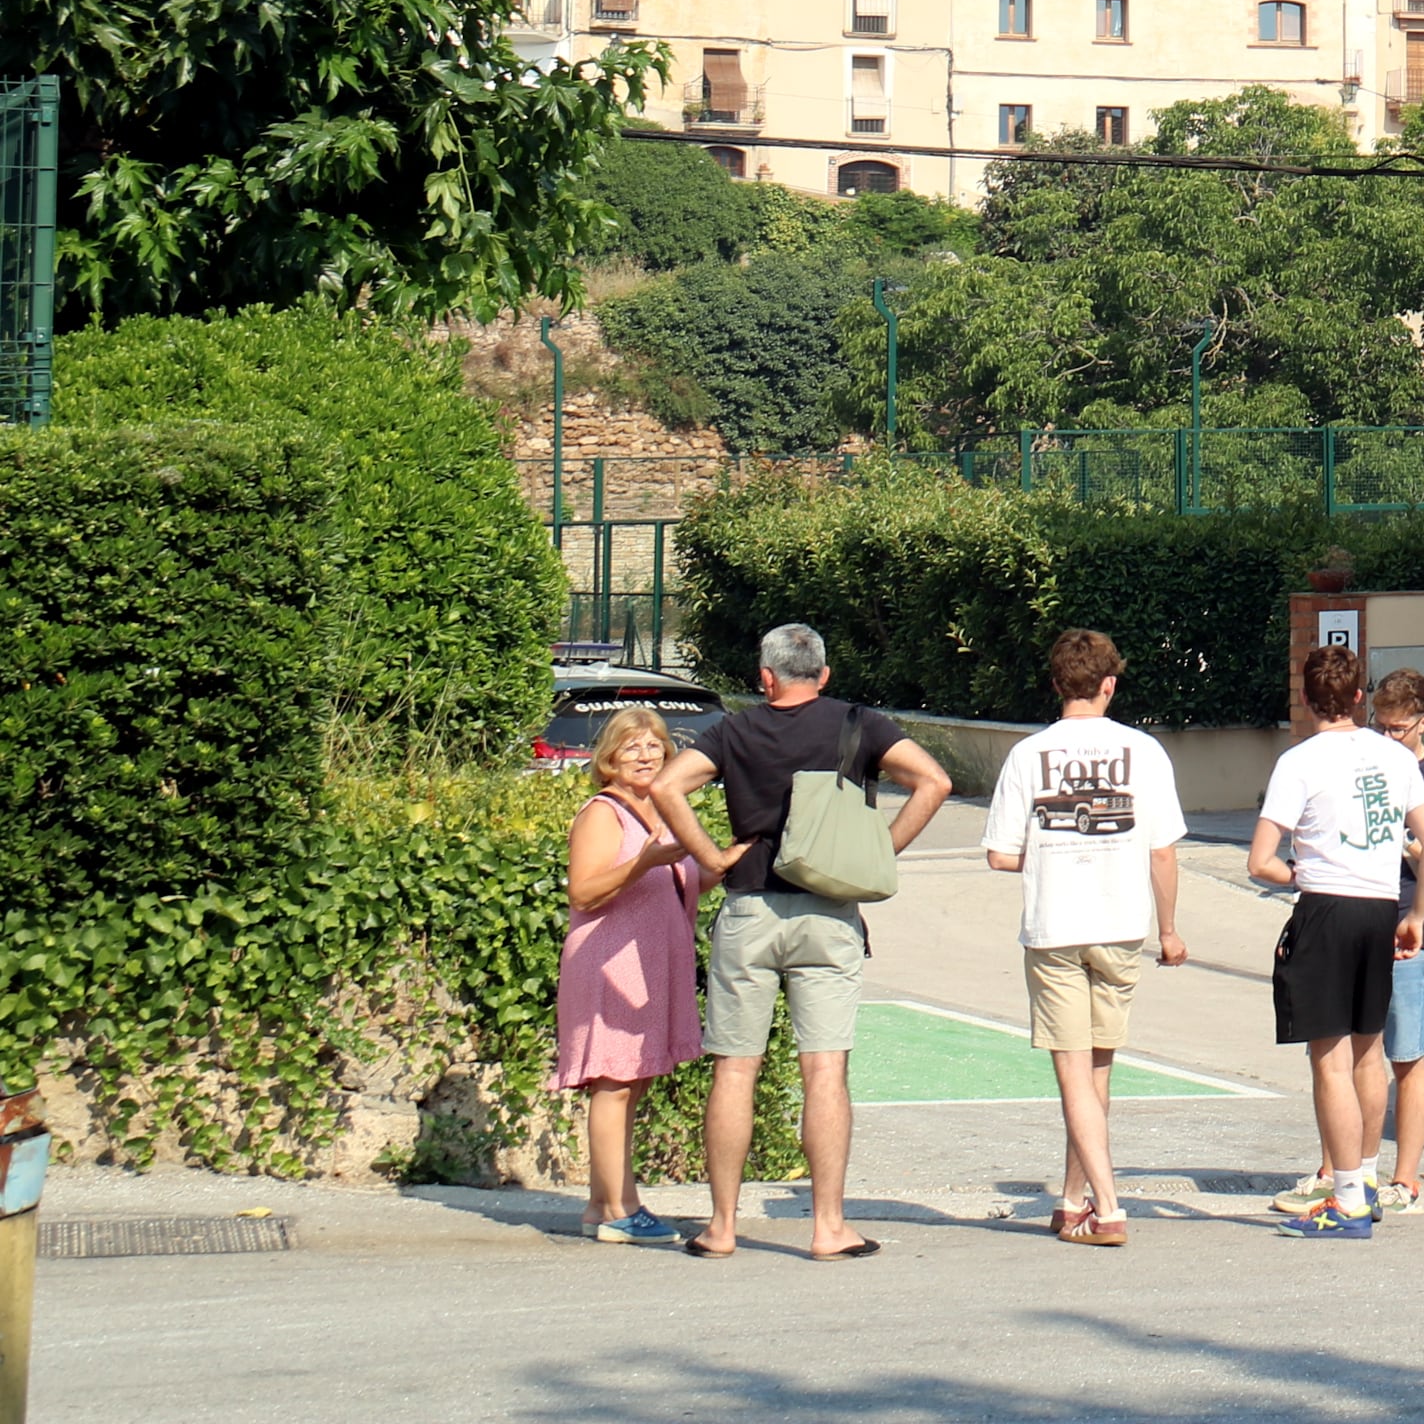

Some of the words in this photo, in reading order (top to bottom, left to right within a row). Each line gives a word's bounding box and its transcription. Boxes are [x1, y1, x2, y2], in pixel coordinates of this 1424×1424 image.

[1331, 632, 1347, 646] P
[574, 700, 657, 713] GUARDIA
[658, 700, 704, 713] CIVIL
[1037, 746, 1131, 791] Ford
[1362, 772, 1388, 792] ES
[1366, 790, 1391, 809] PE
[1367, 806, 1403, 827] RAN
[1369, 825, 1394, 850] ÇA
